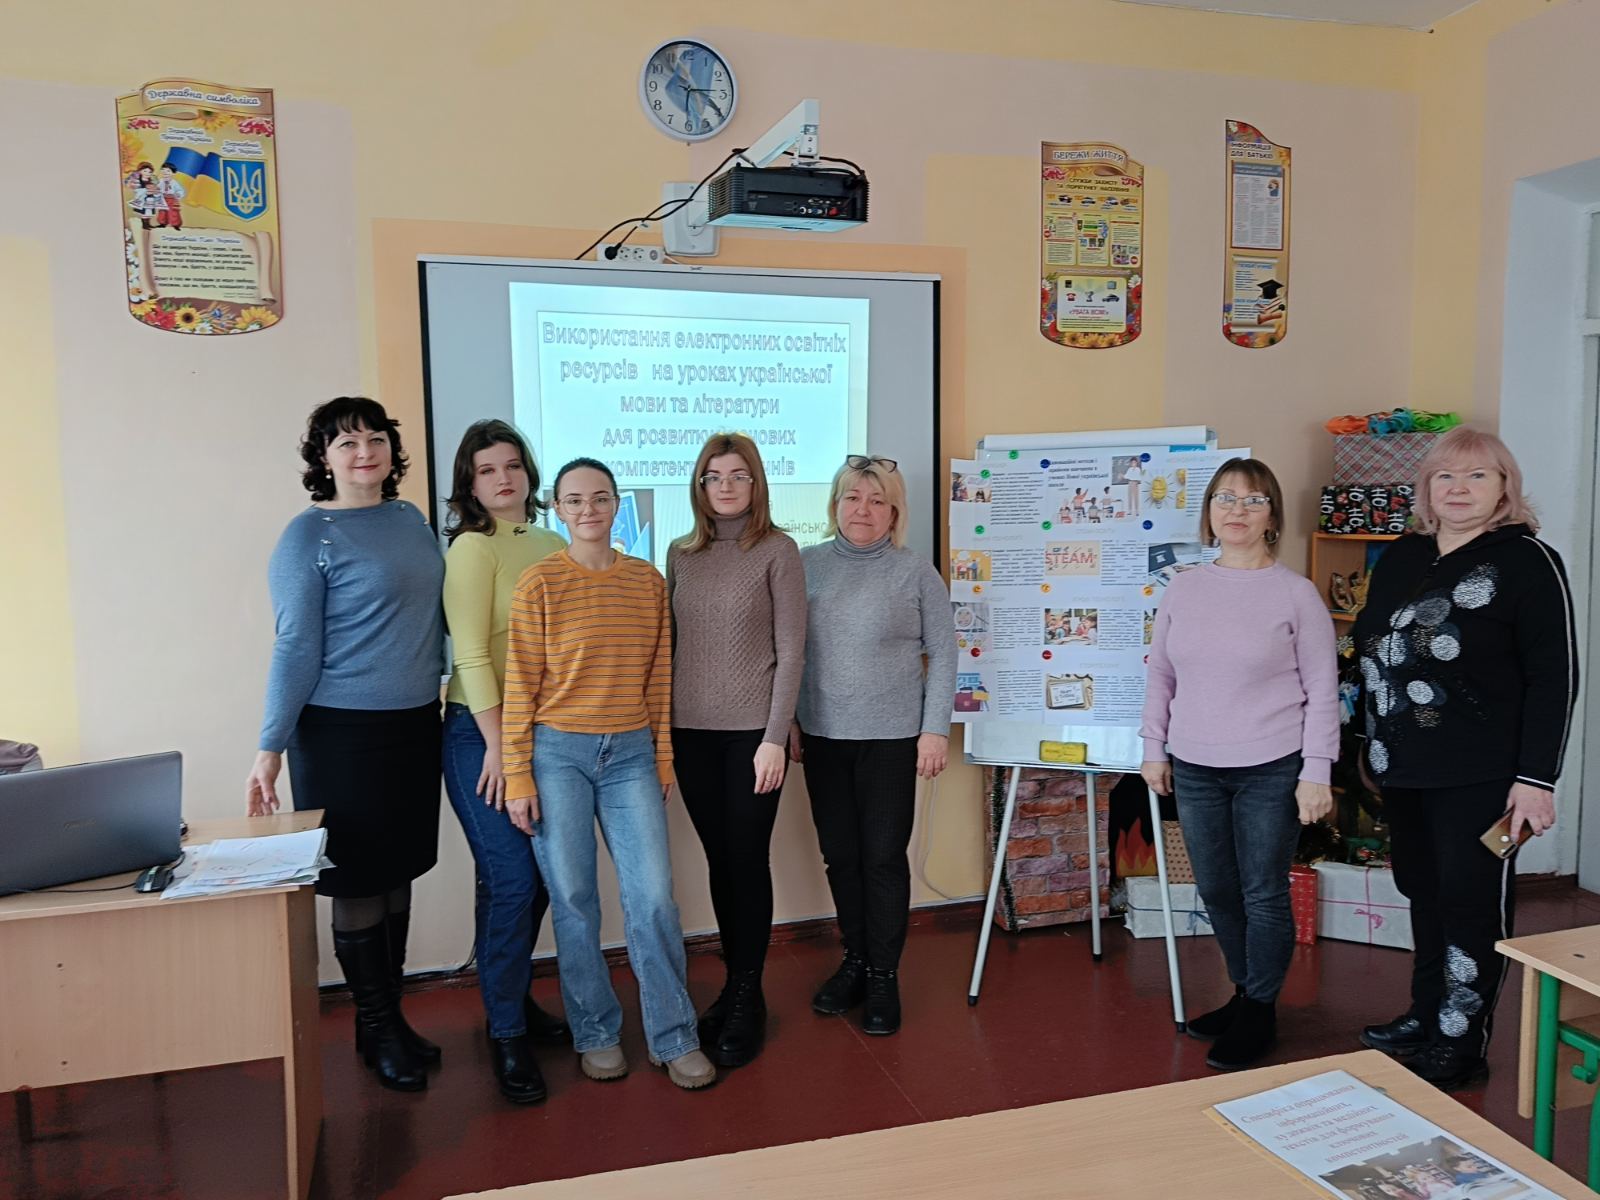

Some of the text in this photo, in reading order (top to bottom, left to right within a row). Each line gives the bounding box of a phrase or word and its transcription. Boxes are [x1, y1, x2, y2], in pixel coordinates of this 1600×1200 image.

[683, 50, 695, 60] 12
[651, 63, 663, 74] 10
[703, 57, 708, 67] 1
[714, 71, 722, 82] 2
[649, 80, 658, 93] 9
[148, 88, 259, 106] Державна символіка
[719, 89, 727, 100] 3
[653, 99, 662, 111] 8
[667, 114, 674, 125] 7
[684, 119, 693, 132] 6
[702, 118, 710, 129] 5
[1054, 151, 1124, 162] БЕРЕЖИ ЖИТТЯ
[542, 321, 847, 354] Використання електронних освітніх
[560, 358, 833, 387] ресурсів на уроках української
[620, 393, 779, 418] мови та літератури
[602, 428, 633, 447] для
[1371, 487, 1388, 507] HO
[1321, 494, 1335, 514] HO
[1348, 507, 1365, 527] HO
[1388, 512, 1405, 532] HO
[1045, 552, 1093, 564] STEAM
[1240, 1104, 1295, 1124] Специфіка
